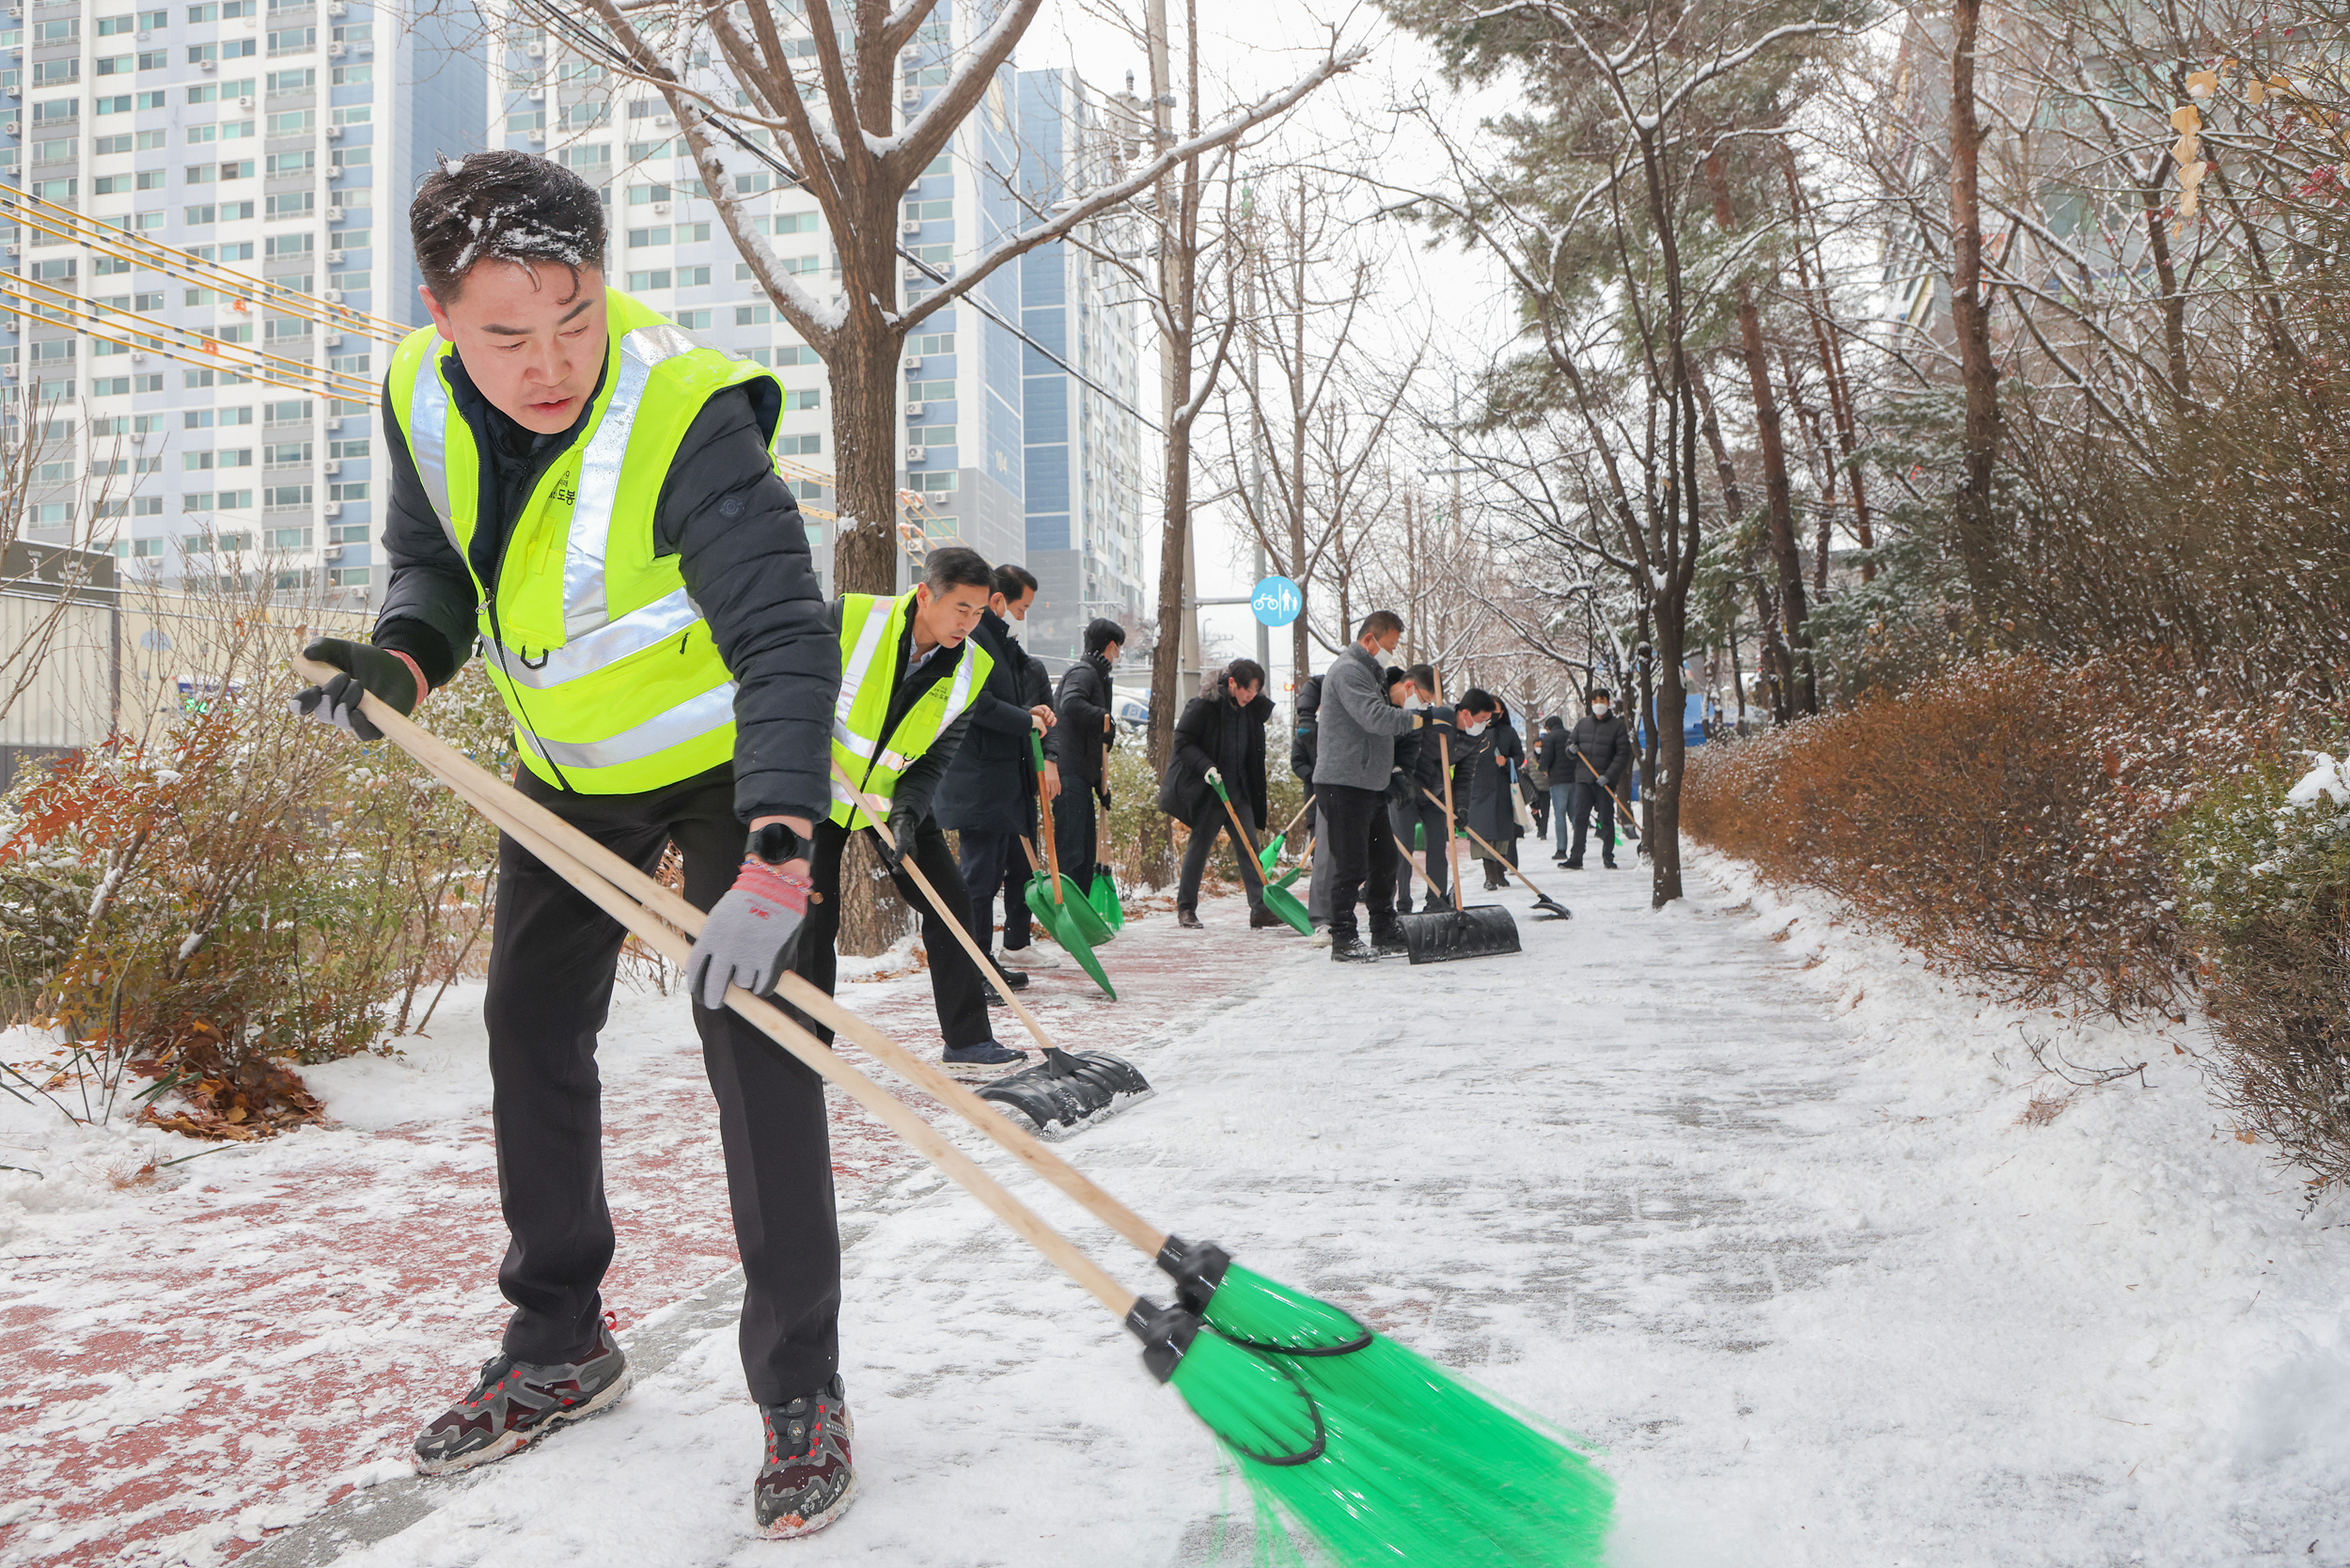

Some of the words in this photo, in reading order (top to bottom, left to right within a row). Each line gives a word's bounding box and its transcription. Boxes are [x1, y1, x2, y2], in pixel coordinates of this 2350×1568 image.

[556, 489, 575, 506] 도봉
[27, 550, 43, 558] GATE
[29, 557, 43, 581] 1
